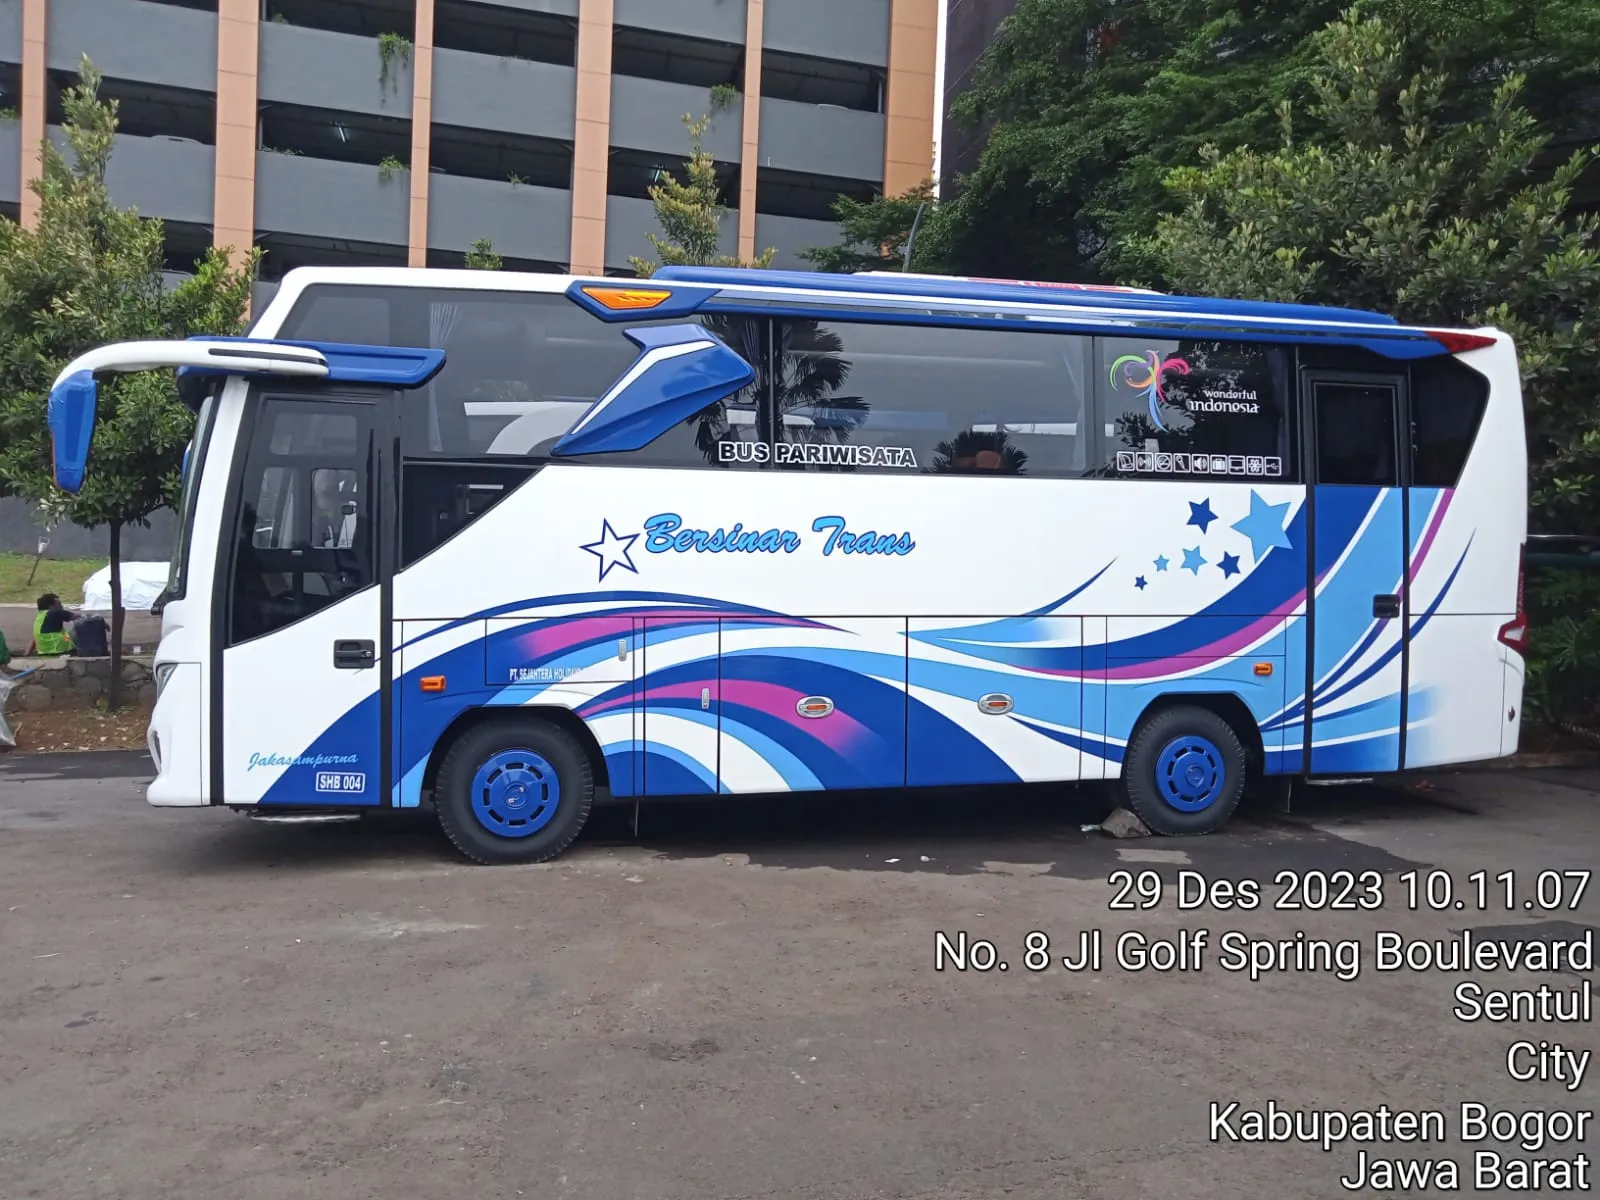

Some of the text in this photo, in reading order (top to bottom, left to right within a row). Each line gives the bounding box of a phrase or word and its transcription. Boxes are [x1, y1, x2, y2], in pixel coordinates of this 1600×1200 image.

[1202, 389, 1257, 400] wonderful
[718, 441, 918, 468] BUS PARIWISATA
[643, 512, 916, 557] Bersinar Trans
[247, 752, 359, 772] Jakasampurna
[319, 774, 362, 791] SHB 004
